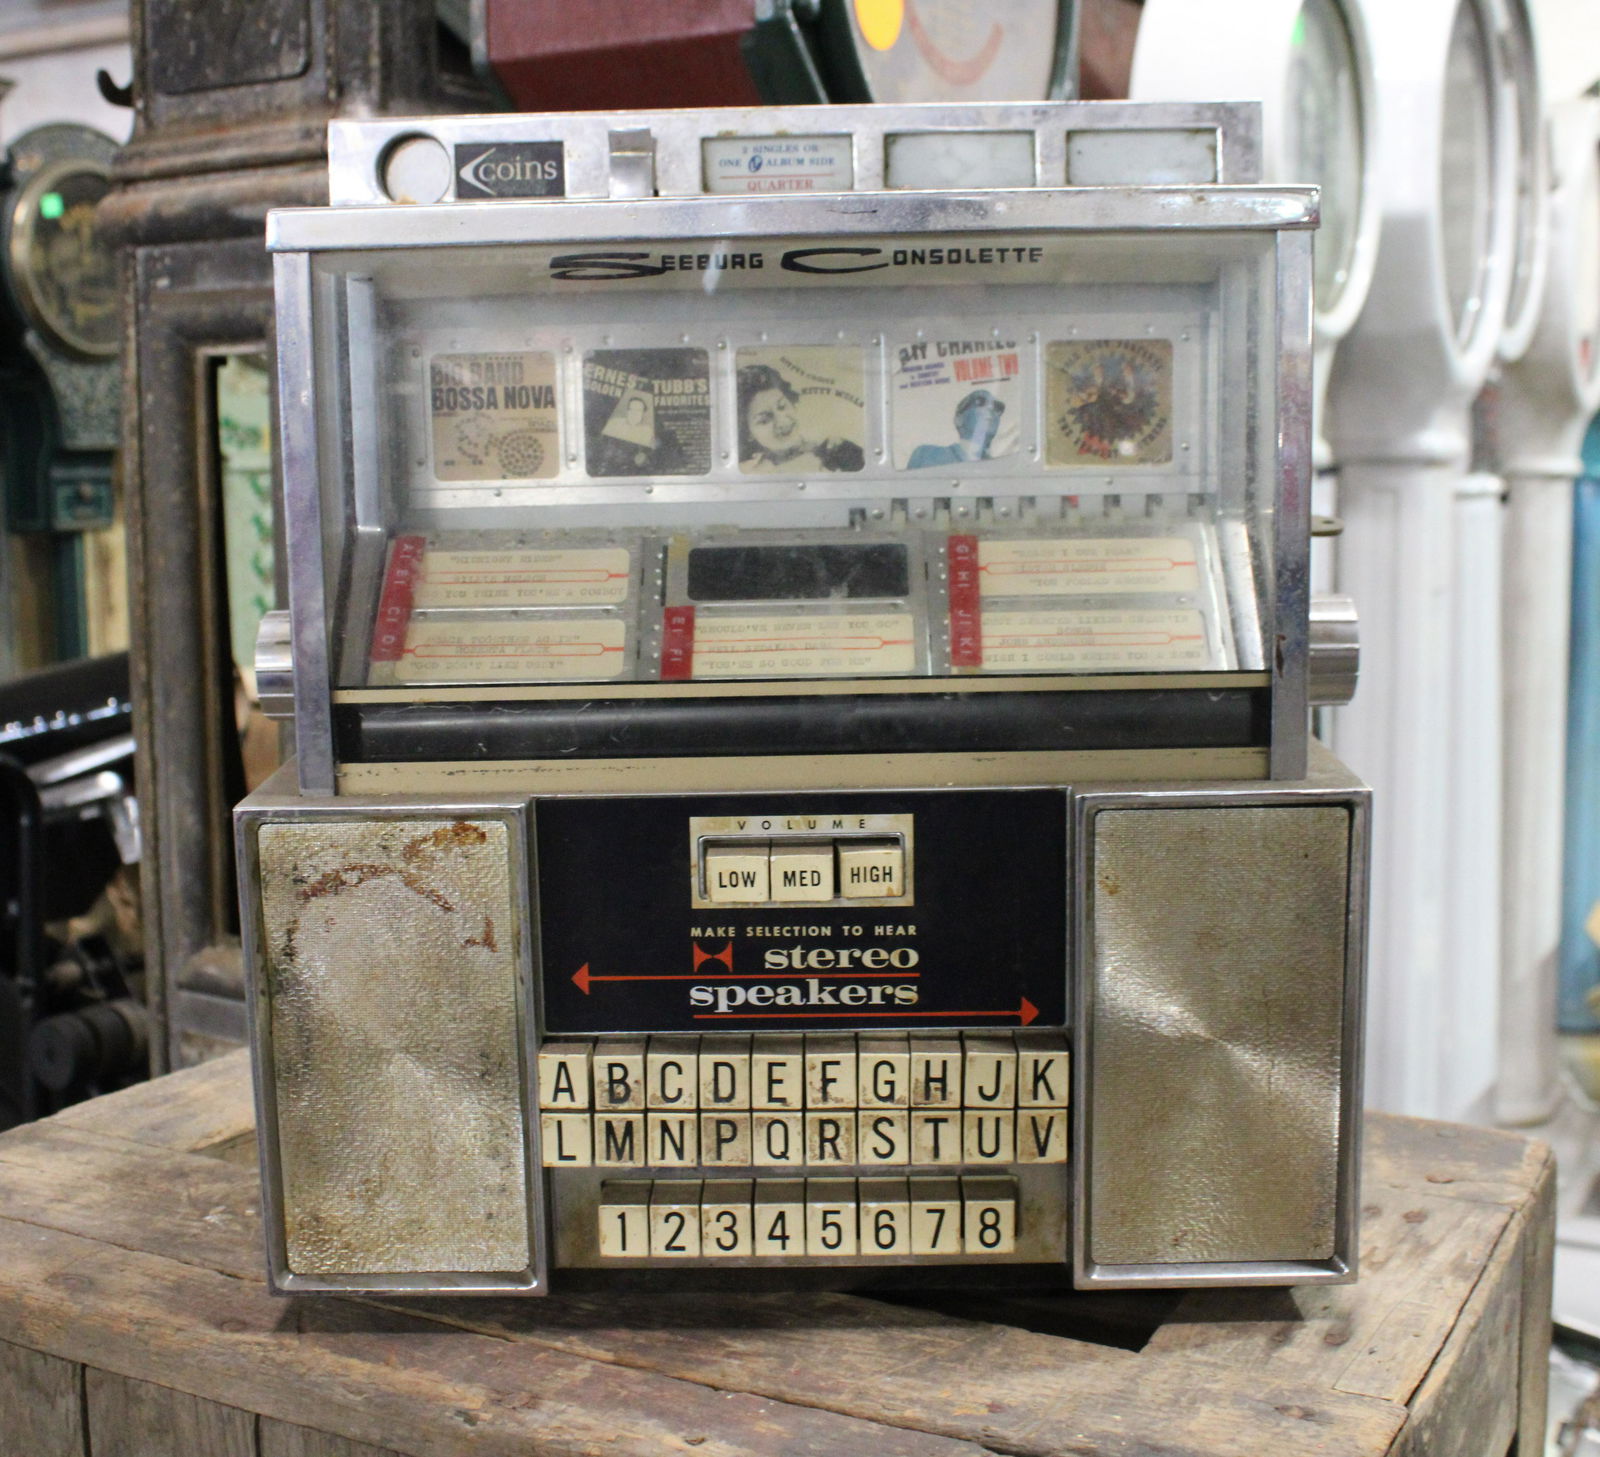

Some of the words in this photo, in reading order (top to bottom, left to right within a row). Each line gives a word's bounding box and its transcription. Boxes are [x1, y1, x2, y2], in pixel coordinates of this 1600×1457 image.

[752, 144, 799, 154] SINGLES
[803, 143, 819, 152] OR
[479, 155, 558, 182] coins
[718, 158, 742, 168] ONE
[766, 157, 805, 167] ALBUM
[809, 157, 835, 166] SIDE
[747, 179, 814, 192] QUARTER
[549, 251, 764, 280] SEEBURG
[780, 246, 1044, 275] CONSOLETTE
[431, 386, 499, 411] BOSSA
[504, 384, 556, 410] NOVA
[737, 818, 866, 831] VOLUME
[718, 871, 757, 889] LOW
[783, 869, 821, 887] MED
[850, 865, 893, 884] HIGH
[690, 926, 736, 938] MAKE
[746, 925, 832, 937] SELECTION
[842, 925, 864, 937] TO
[874, 924, 918, 936] HEAR
[763, 944, 920, 970] stereo
[689, 978, 919, 1013] speakers
[552, 1061, 576, 1103] A
[607, 1062, 632, 1105] B
[660, 1061, 684, 1104] C
[713, 1061, 736, 1103] D
[767, 1061, 788, 1104] E
[820, 1060, 841, 1102] F
[873, 1060, 896, 1103] G
[924, 1059, 948, 1101] H
[977, 1059, 1002, 1102] J
[1032, 1058, 1056, 1101] K
[557, 1120, 577, 1162] L
[605, 1119, 635, 1162] M
[659, 1119, 685, 1161] N
[715, 1119, 738, 1161] P
[766, 1118, 790, 1161] Q
[818, 1118, 842, 1161] R
[872, 1116, 896, 1160] S
[924, 1117, 949, 1160] T
[977, 1116, 1001, 1159] U
[1030, 1115, 1055, 1158] V
[617, 1211, 627, 1252] 1
[663, 1211, 687, 1252] 2
[715, 1210, 739, 1252] 3
[767, 1210, 790, 1251] 4
[821, 1209, 843, 1250] 5
[874, 1209, 897, 1250] 6
[926, 1208, 946, 1250] 7
[978, 1207, 1001, 1249] 8
